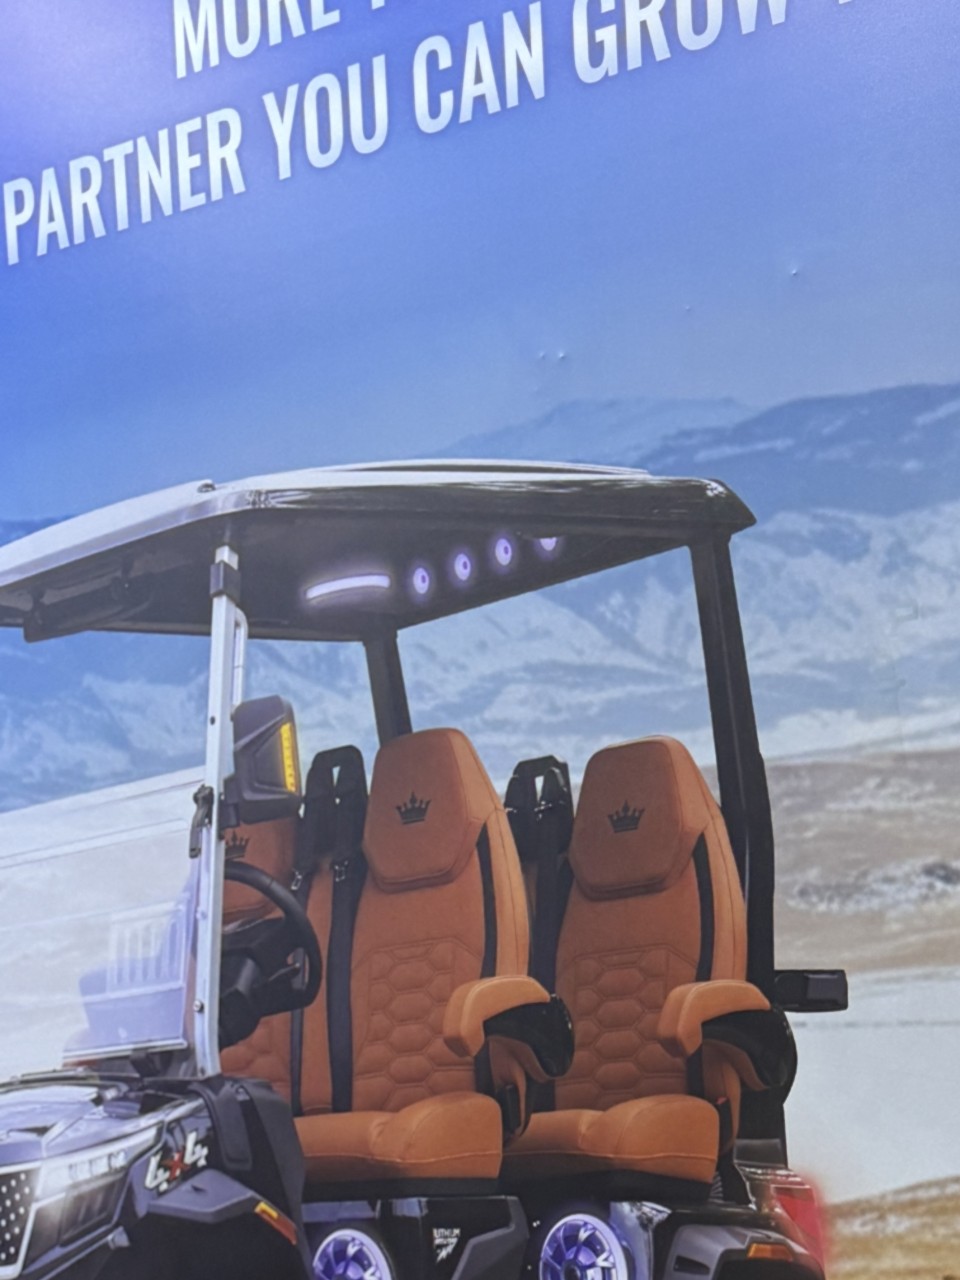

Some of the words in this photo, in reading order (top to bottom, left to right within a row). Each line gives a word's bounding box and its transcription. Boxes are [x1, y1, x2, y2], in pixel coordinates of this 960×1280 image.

[3, 107, 247, 266] PARTNER
[261, 53, 389, 181] YOU
[412, 1, 546, 135] CAN
